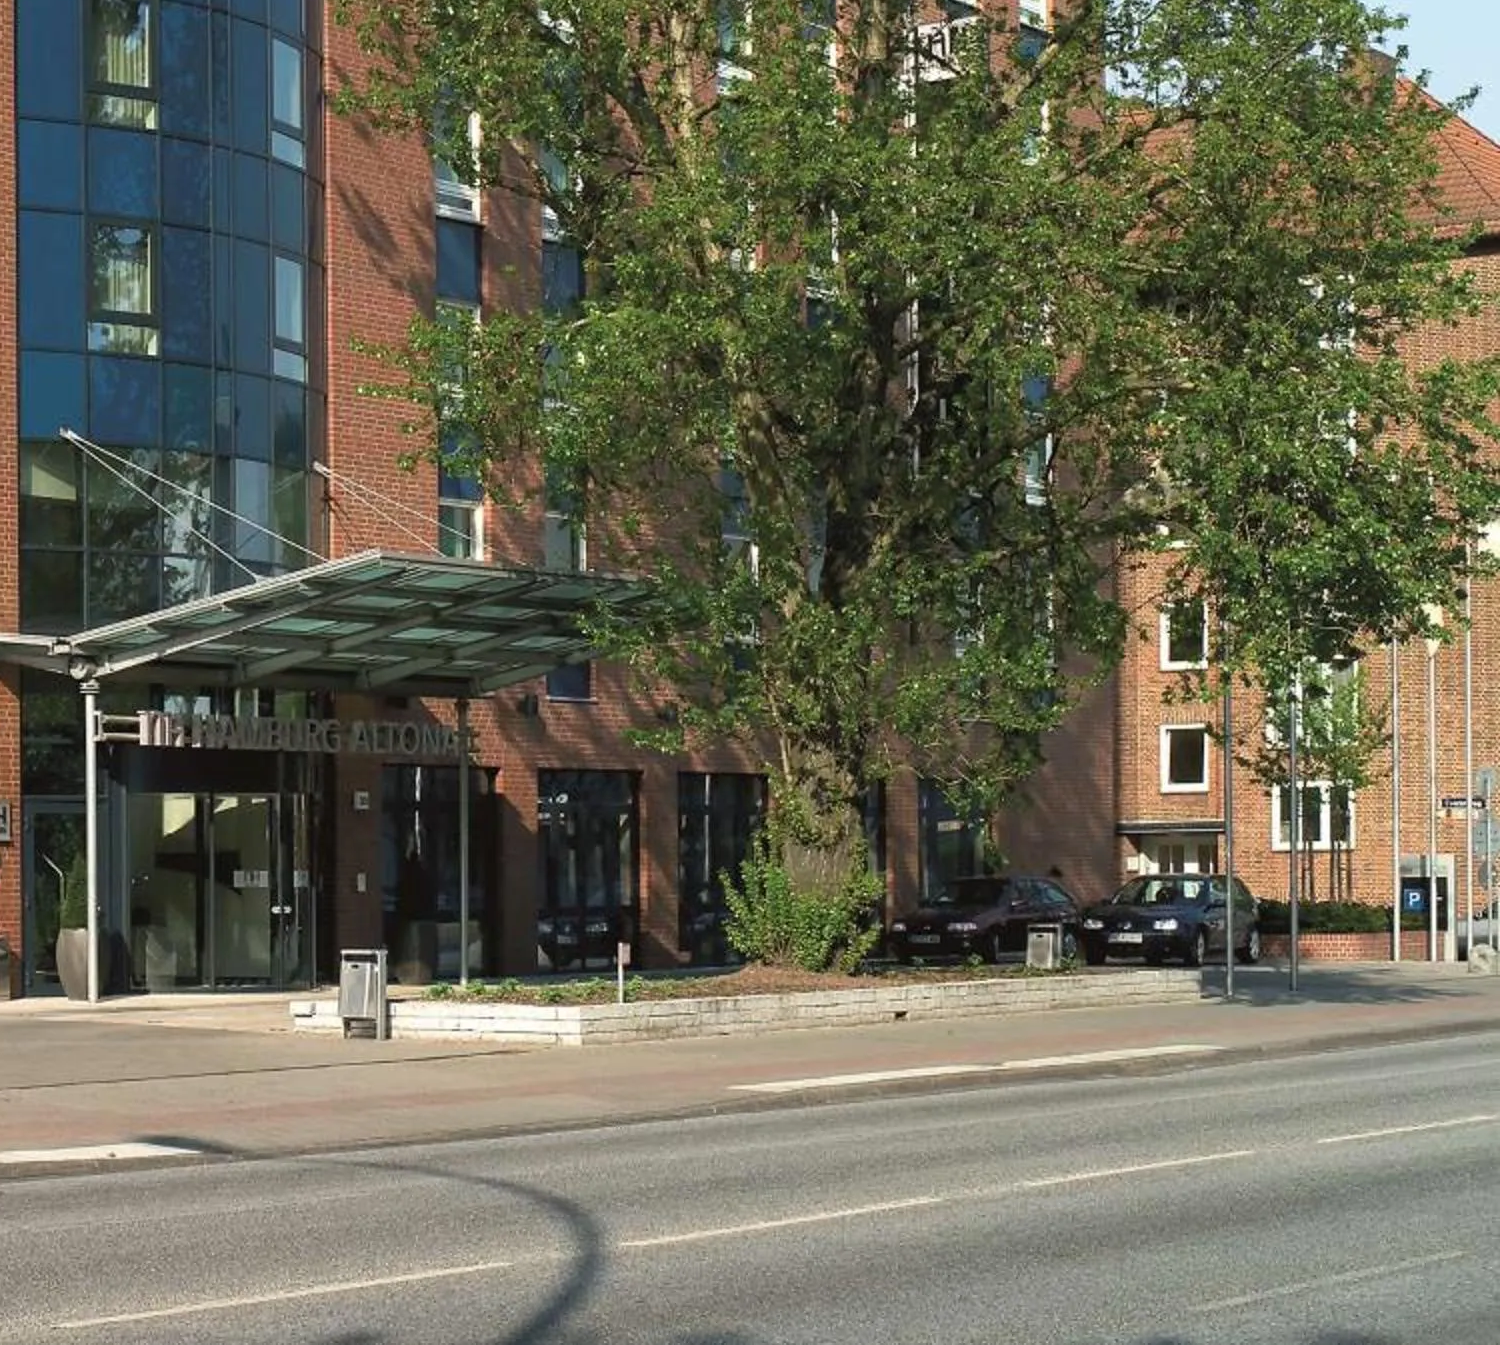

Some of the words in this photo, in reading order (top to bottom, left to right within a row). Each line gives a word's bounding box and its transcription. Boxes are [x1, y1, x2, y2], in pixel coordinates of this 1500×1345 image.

[191, 713, 342, 753] HAMBURG
[353, 719, 460, 755] ALTONA
[1408, 892, 1421, 906] P
